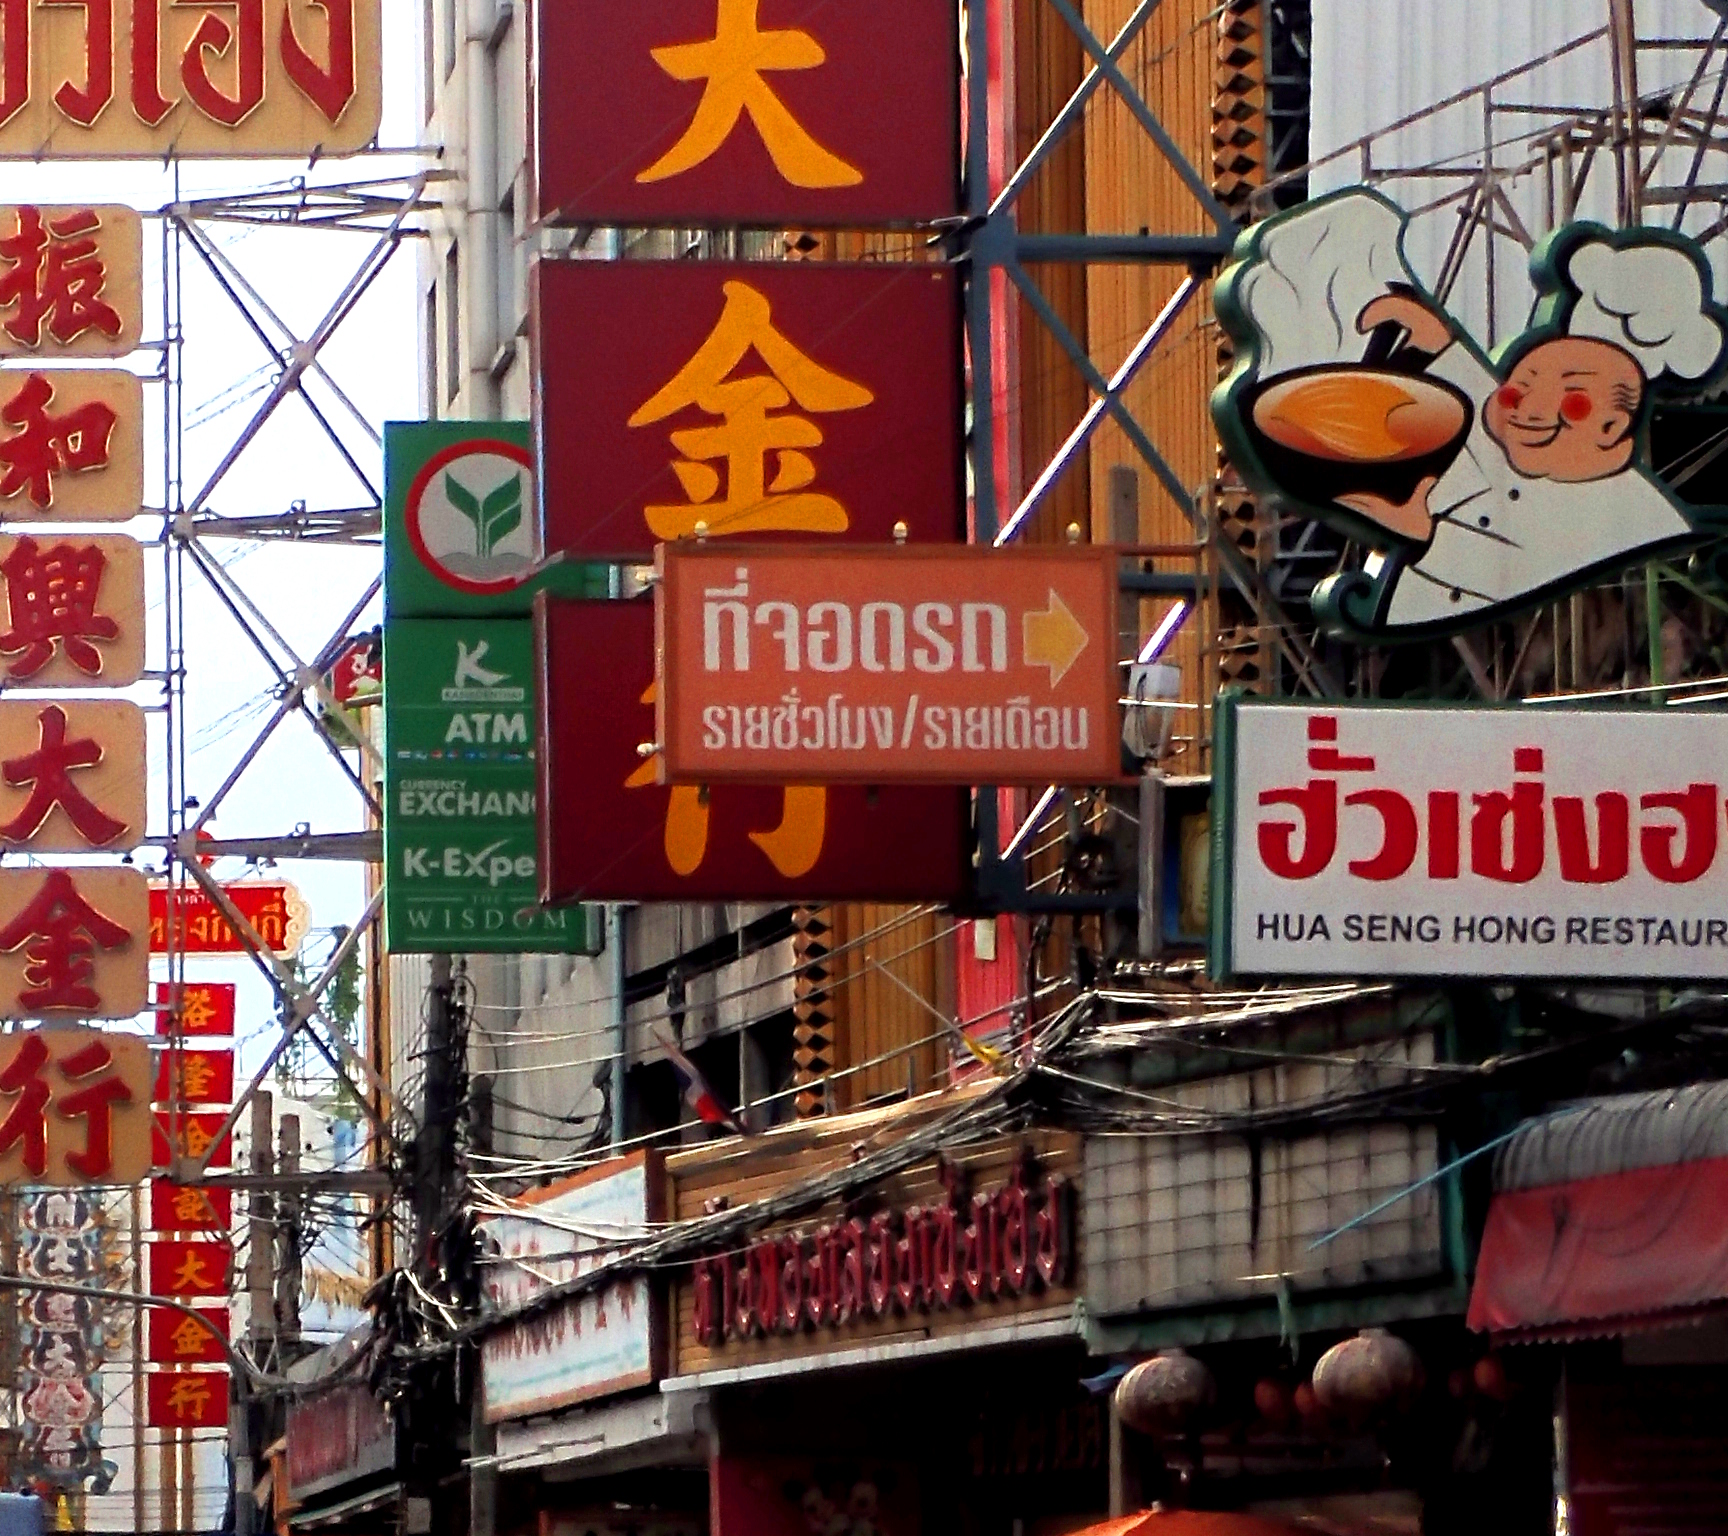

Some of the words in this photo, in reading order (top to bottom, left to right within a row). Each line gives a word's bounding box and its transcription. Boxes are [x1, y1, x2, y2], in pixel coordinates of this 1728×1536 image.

[702, 567, 1008, 672] ที่จอดรถ
[444, 712, 528, 744] ATM
[398, 791, 537, 817] EXCHAN
[1257, 715, 1728, 884] ฮั่วเซ่งฮ
[403, 837, 537, 888] K-Expe
[408, 908, 568, 930] WISDOM
[1257, 913, 1331, 942] HUA
[1343, 914, 1440, 943] SENG
[1452, 915, 1557, 945] HONG
[1566, 916, 1728, 947] RESTAUR
